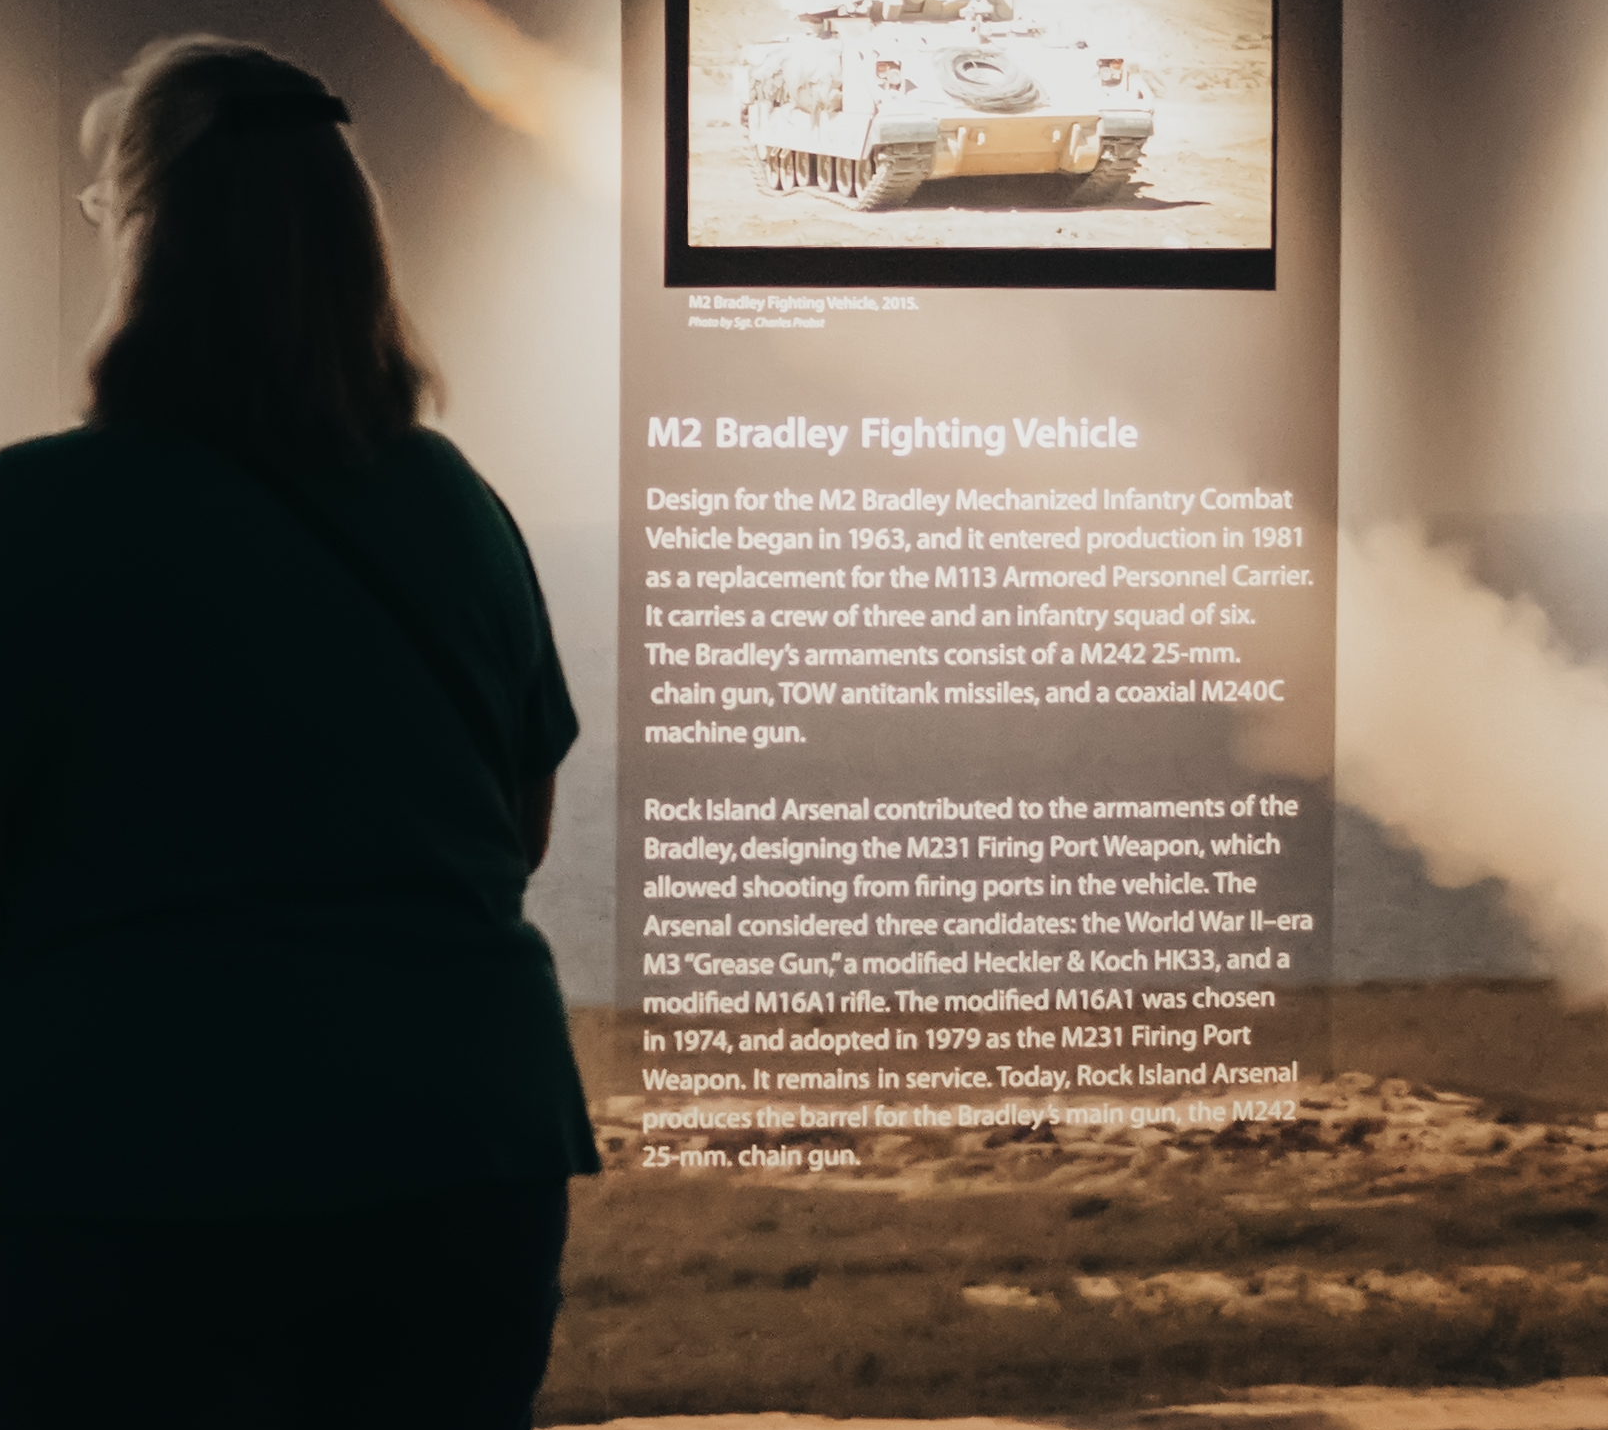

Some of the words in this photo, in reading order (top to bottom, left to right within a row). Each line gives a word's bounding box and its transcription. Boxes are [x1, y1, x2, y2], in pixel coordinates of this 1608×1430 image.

[688, 294, 712, 310] M2
[712, 294, 766, 313] Bradley
[767, 294, 826, 313] Fighting
[826, 295, 879, 311] Vehicle,
[882, 296, 919, 310] 2015.
[647, 416, 703, 448] M2
[715, 415, 849, 457] Bradley
[861, 416, 1006, 457] Fighting
[1012, 416, 1138, 448] Vehicle
[646, 486, 730, 517] Design
[734, 486, 770, 512] for
[772, 487, 814, 512] the
[818, 488, 857, 512] M2
[862, 487, 951, 517] Bradley
[955, 487, 1098, 511] Mechanized
[1103, 486, 1196, 516] Infantry
[1199, 486, 1294, 511] Combat
[644, 525, 733, 550] Vehicle
[737, 525, 814, 556] began
[818, 527, 842, 550] in
[848, 527, 912, 553] 1963,
[916, 526, 963, 550] and
[967, 527, 985, 550] it
[988, 526, 1081, 550] entered
[1086, 526, 1217, 555] production
[1222, 526, 1244, 548] in
[1252, 526, 1303, 548] 1981
[645, 569, 673, 589] as
[675, 569, 692, 589] a
[696, 564, 847, 594] replacement
[850, 564, 886, 589] for
[888, 564, 930, 589] the
[934, 565, 998, 589] M113
[1002, 564, 1107, 588] Armored
[1112, 564, 1227, 588] Personnel
[1232, 564, 1314, 587] Carrier.
[644, 797, 703, 822] Rock
[706, 796, 777, 822] Island
[781, 796, 870, 822] Arsenal
[873, 796, 1014, 821] contributed
[1017, 799, 1045, 820] to
[1048, 796, 1089, 820] the
[1092, 797, 1226, 820] armaments
[1229, 793, 1257, 818] of
[1259, 793, 1300, 818] the
[641, 1139, 733, 1169] 25-mm.
[737, 1143, 804, 1169] chain
[806, 1148, 863, 1176] gun.
